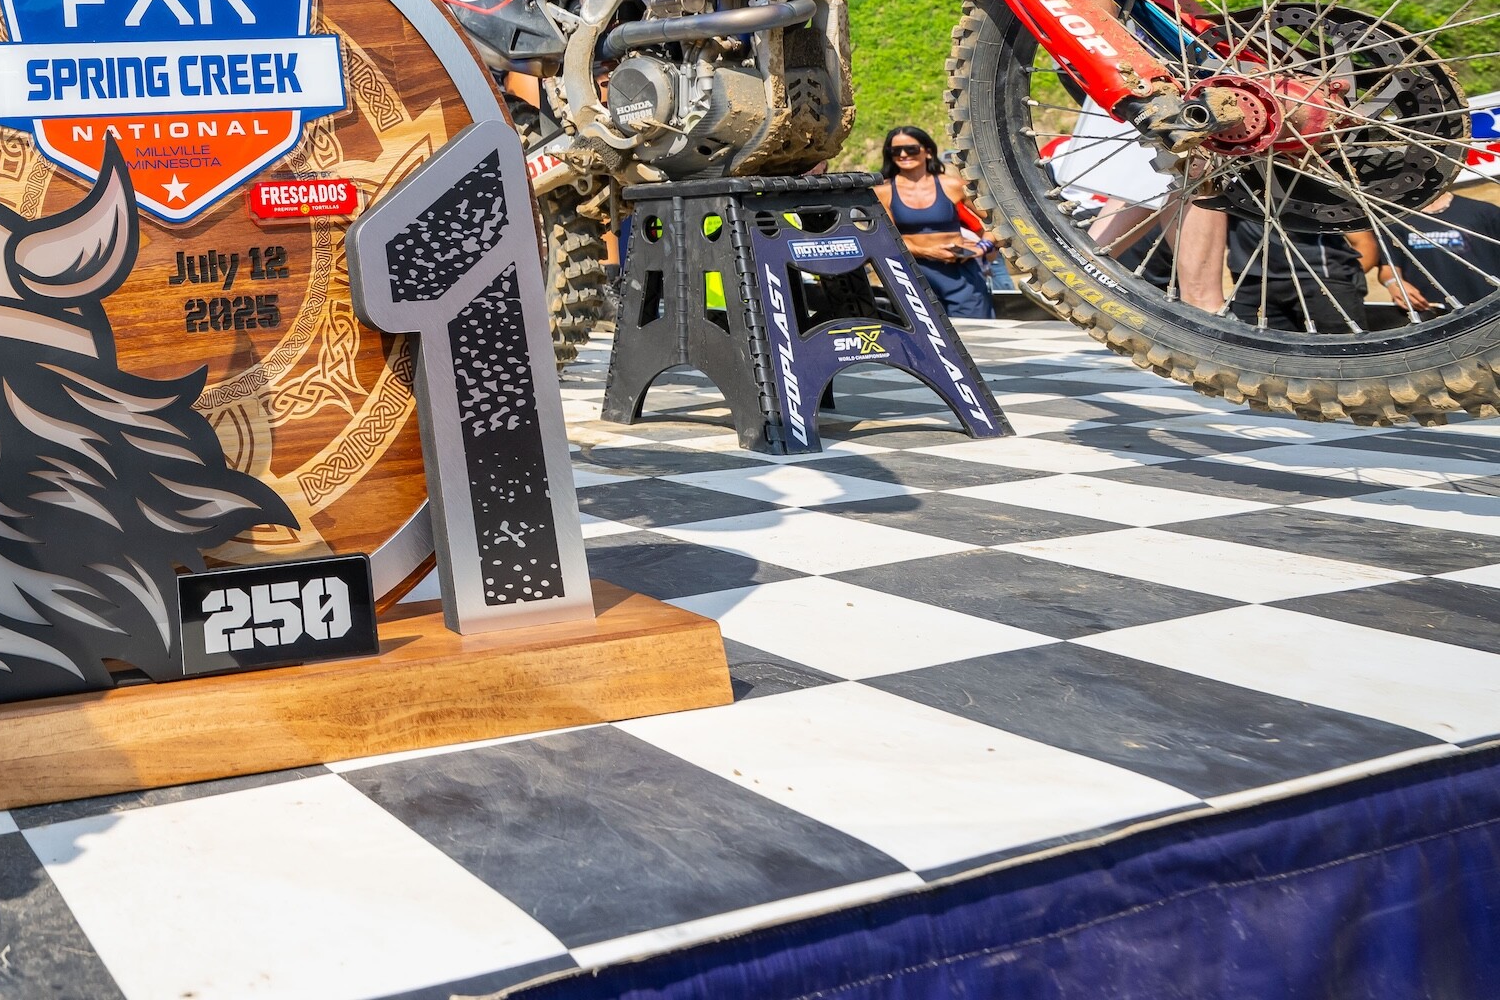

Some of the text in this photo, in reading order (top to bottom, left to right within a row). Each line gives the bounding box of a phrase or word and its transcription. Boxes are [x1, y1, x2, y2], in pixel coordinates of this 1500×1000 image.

[27, 52, 303, 101] SPRING CREEK
[615, 100, 654, 115] HONDA
[72, 119, 270, 142] NATIONAL
[127, 157, 222, 170] MINNESOTA
[135, 144, 211, 157] MILLVILLE
[260, 183, 347, 206] FRESCADOS
[793, 242, 858, 255] MOTOCROSS
[168, 245, 290, 290] July 12
[184, 294, 281, 333] 2025
[764, 263, 809, 447] UFOPLAST
[833, 329, 886, 355] SMX
[884, 257, 994, 430] UFOPLAST
[201, 575, 351, 655] 250
